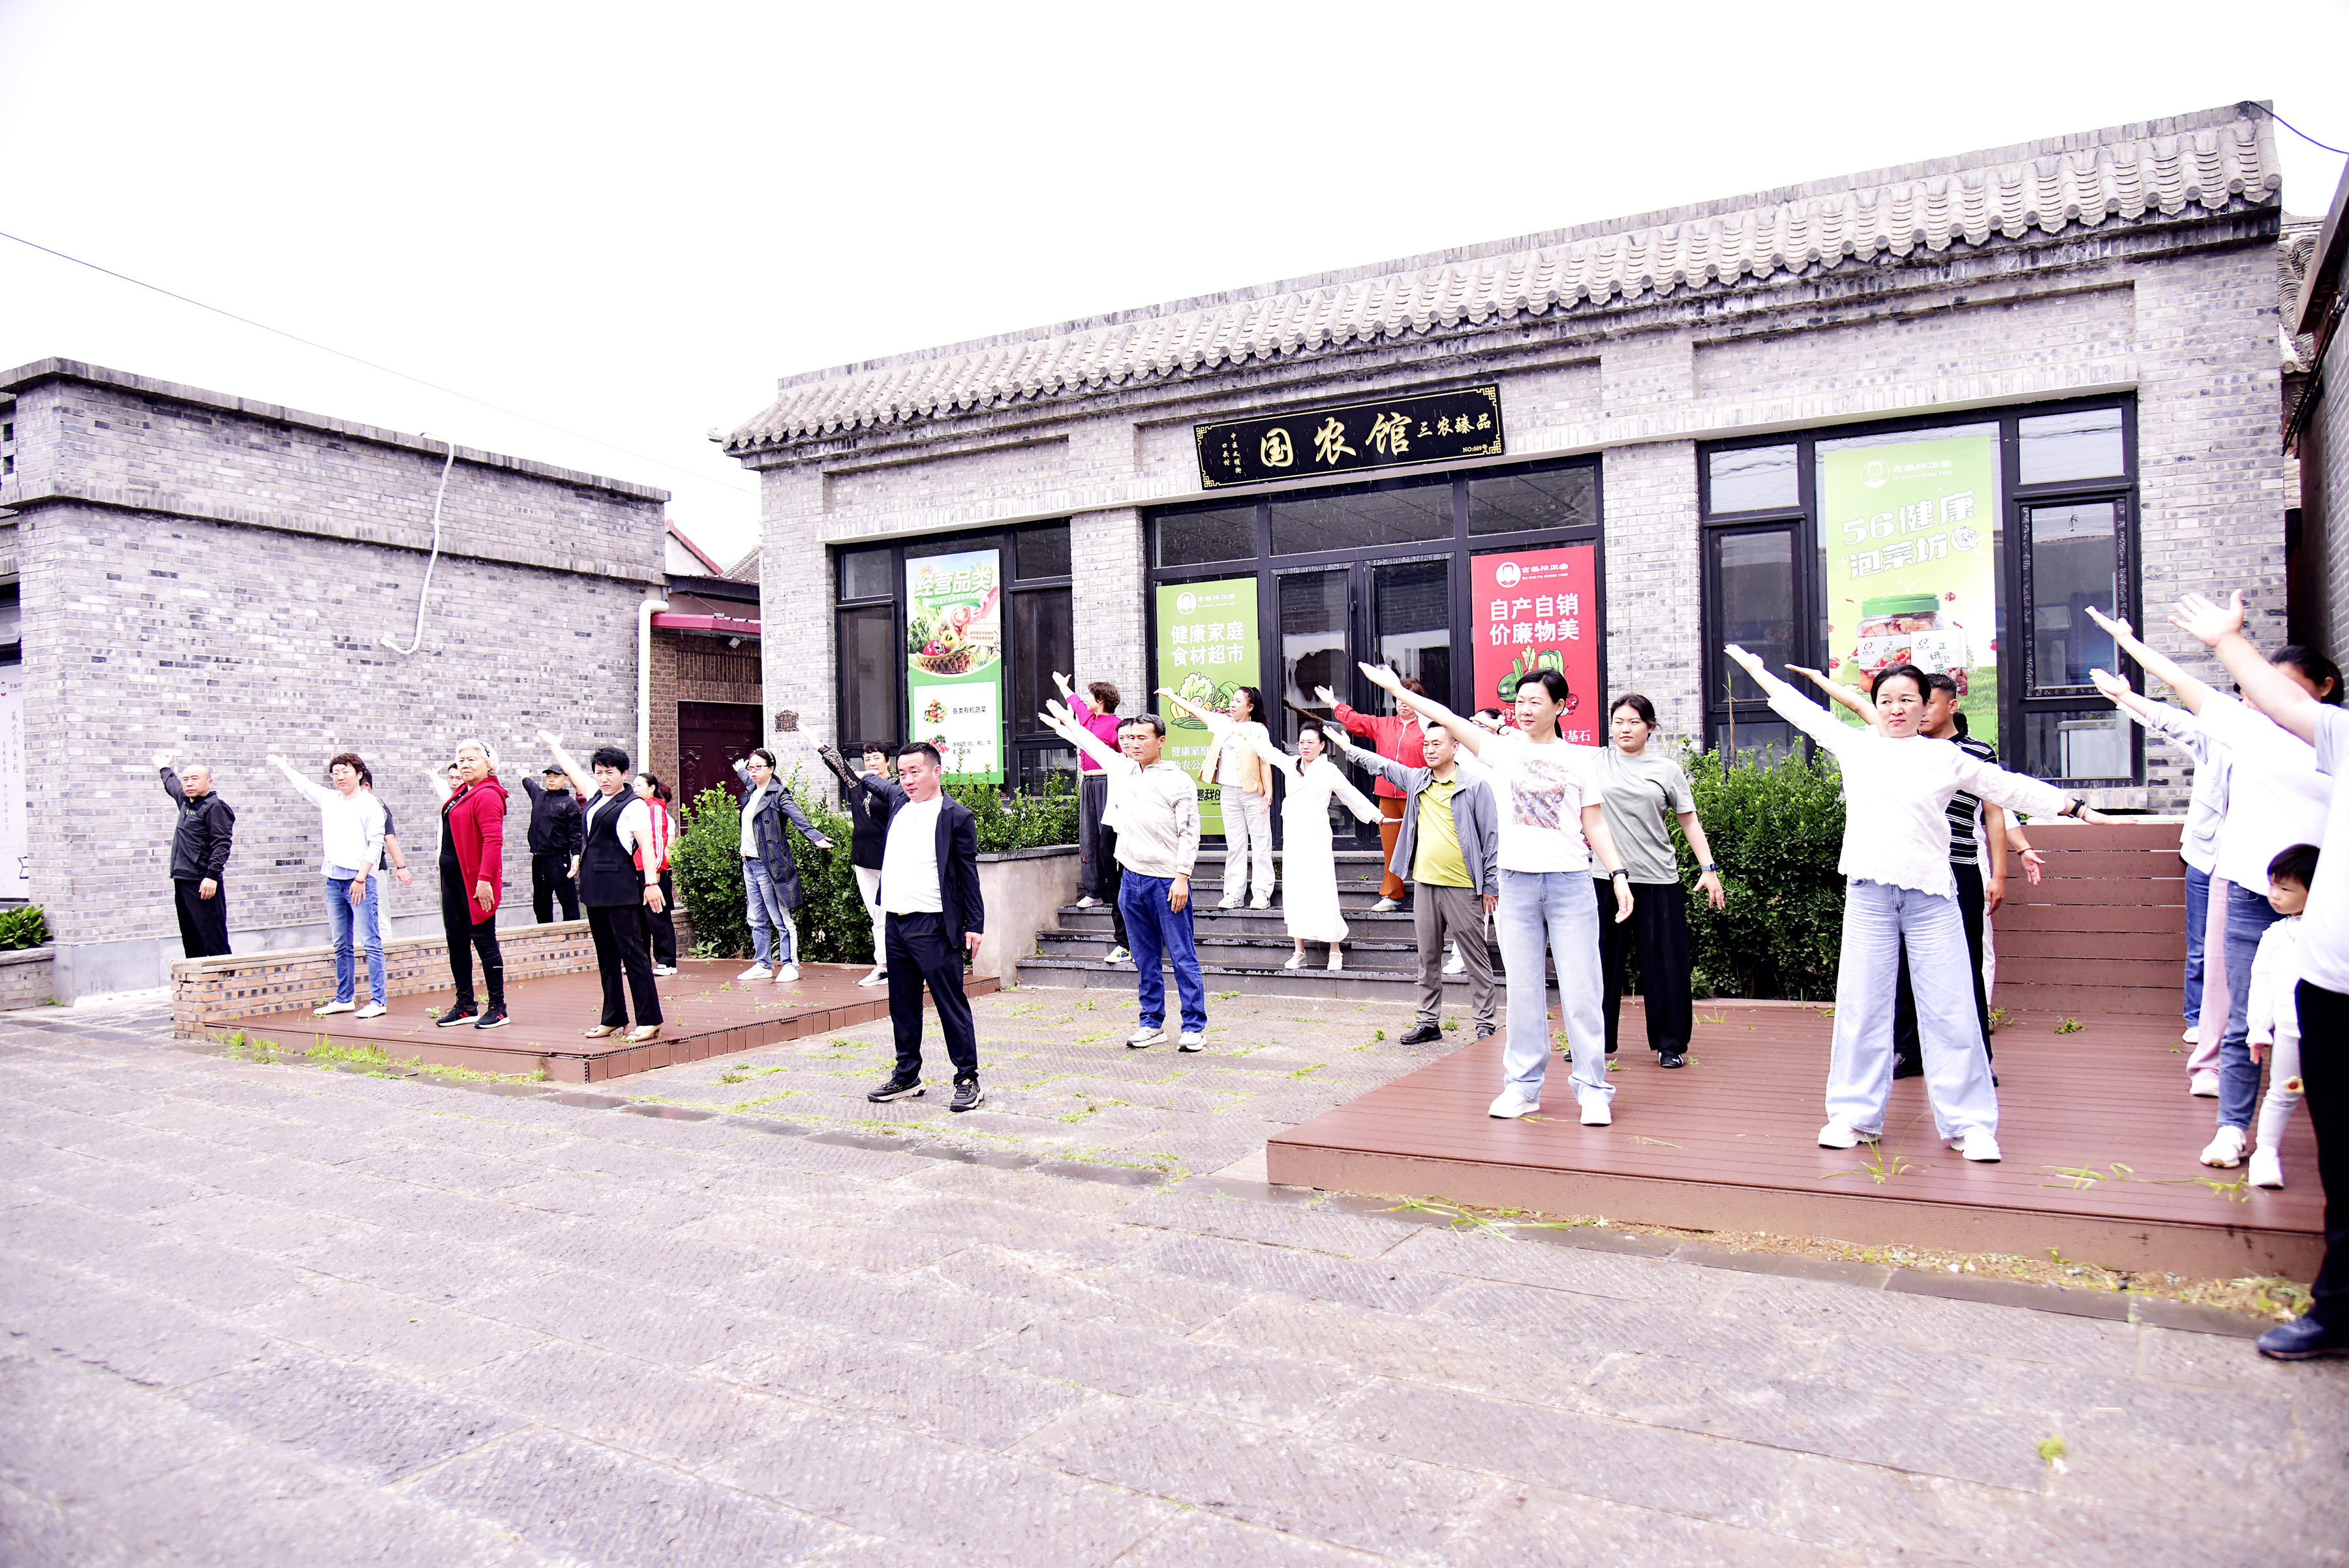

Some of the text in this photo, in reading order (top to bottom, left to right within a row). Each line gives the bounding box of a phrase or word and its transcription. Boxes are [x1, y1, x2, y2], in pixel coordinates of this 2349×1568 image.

[1261, 412, 1412, 467] 国农馆
[1462, 444, 1488, 453] NO:009号
[1843, 489, 1978, 546] 56健康
[1848, 532, 1949, 579] 泡菜坊
[914, 566, 993, 598] 经营品类
[1490, 592, 1579, 621] 自产自销
[1171, 620, 1244, 645] 健康家庭
[1489, 618, 1580, 646] 价廉物美
[1171, 642, 1245, 668] 食材超市
[953, 705, 987, 715] 各类有机蔬菜
